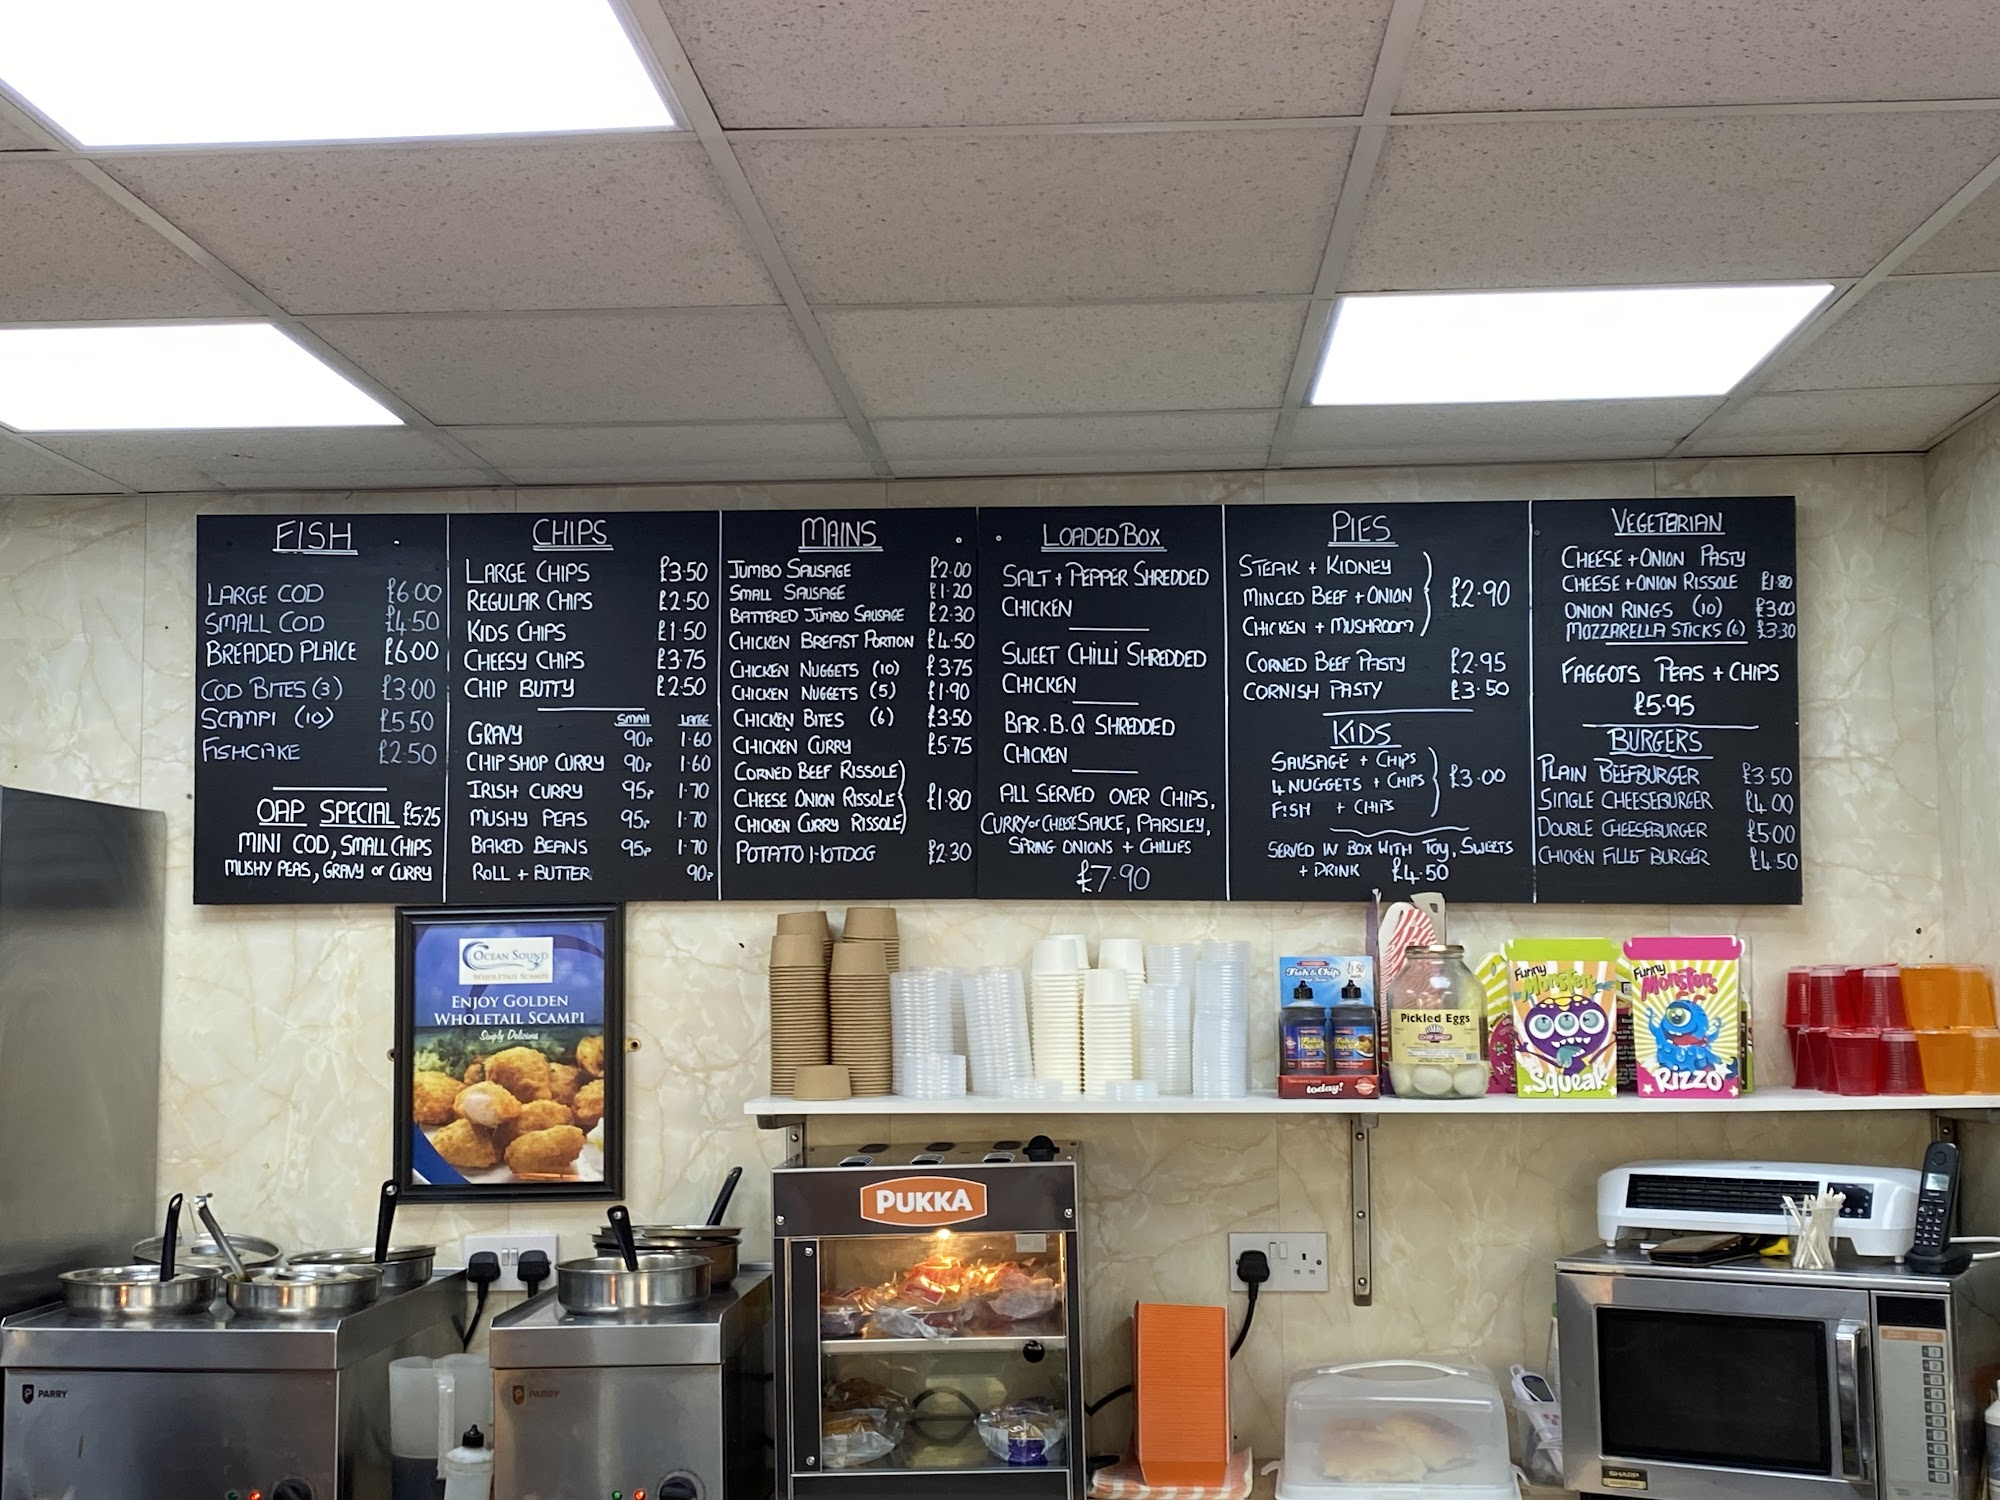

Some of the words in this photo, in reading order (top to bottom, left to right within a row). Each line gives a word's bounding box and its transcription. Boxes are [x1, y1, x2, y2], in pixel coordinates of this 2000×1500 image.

[275, 520, 352, 550] FISH
[532, 519, 607, 545] CHIPS
[801, 518, 876, 547] MAINS
[1043, 524, 1119, 546] LOADED
[1119, 522, 1160, 546] BOX
[1332, 510, 1392, 542] PIES
[1239, 554, 1301, 577] STEAK
[1327, 554, 1391, 575] KIDNEY
[1562, 546, 1623, 568] CHEESE
[1640, 547, 1684, 567] ONION
[1701, 544, 1745, 567] PASTY
[466, 559, 527, 583] LARGE
[536, 560, 590, 582] CHIPS
[727, 560, 782, 578] JUMBO
[787, 558, 851, 578] SAUSAGE
[1003, 564, 1051, 587] SALT
[1065, 562, 1128, 587] PEPPER
[1133, 560, 1209, 586] SHREDDED
[1683, 572, 1738, 590] RISSOLE
[208, 583, 267, 606] LARGE
[278, 584, 324, 603] COD
[467, 589, 540, 611] REGULAR
[729, 584, 772, 601] SMALL
[1312, 586, 1348, 605] BEEF
[1367, 585, 1412, 604] ONION
[730, 607, 799, 623] BATTERED
[1002, 596, 1072, 617] CHICKEN
[1622, 601, 1673, 618] RINGS
[205, 612, 272, 635] SMALL
[279, 611, 324, 632] COD
[468, 619, 509, 642] KIDS
[1242, 616, 1306, 636] CHICKEN
[1331, 617, 1414, 634] MUSHROOM
[1566, 622, 1666, 642] MOZZARELLA
[1671, 621, 1722, 638] STICKS
[729, 631, 790, 650] CHICKEN
[801, 631, 859, 649] BREAST
[864, 629, 914, 648] PORTION
[206, 640, 293, 667] BREADED
[300, 640, 357, 663] PLAICE
[464, 649, 527, 671] CHEESY
[1002, 641, 1060, 665] SWEET
[1127, 642, 1207, 667] SHREDDED
[1246, 651, 1307, 673] CORNED
[1356, 649, 1405, 672] PASTY
[800, 660, 859, 677] NUGGETS
[1562, 656, 1641, 683] FAGGOTS
[1654, 656, 1704, 682] PEAS
[1729, 661, 1779, 681] CHIPS
[249, 676, 306, 699] BITES
[464, 677, 508, 698] CHIP
[520, 678, 574, 698] BUTTY
[1002, 673, 1076, 693] CHICKEN
[1243, 682, 1319, 700] CORNISH
[201, 707, 276, 729] SCAMPI
[803, 708, 844, 728] BITES
[1095, 714, 1175, 736] SHREDDED
[468, 721, 522, 745] GRAVY
[1332, 719, 1392, 747] KIDS
[1607, 728, 1703, 754] BURGERS
[203, 736, 300, 762] FISHCAKE
[808, 735, 851, 754] CURRY
[1004, 743, 1067, 763] CHICKEN
[466, 751, 505, 771] CHIP
[508, 754, 549, 771] SHOP
[555, 753, 604, 771] CURRY
[734, 761, 792, 781] CORNED
[797, 761, 832, 779] BEEF
[840, 760, 899, 779] RISSOLE
[1271, 751, 1349, 772] SAUSAGE
[1376, 750, 1416, 770] CHIPS
[1537, 753, 1586, 782] PLAIN
[1593, 758, 1700, 785] BEEFBURGER
[466, 780, 519, 799] IRISH
[1000, 783, 1029, 802] ALL
[1036, 783, 1095, 803] SERVED
[1109, 788, 1150, 805] OVER
[1288, 777, 1362, 794] NUGGETS
[733, 788, 788, 808] CHEESE
[795, 788, 835, 807] ONION
[1601, 790, 1714, 810] CHEESEBURGER
[257, 799, 305, 823] OAP
[320, 800, 395, 824] SPECIAL
[470, 809, 528, 827] MUSHY
[542, 809, 587, 827] PEAS
[980, 812, 1033, 835] CURRY
[1537, 816, 1593, 837] DOUBLE
[239, 832, 281, 853] MINI
[340, 834, 388, 856] SMALL
[391, 835, 432, 856] CHIPS
[471, 835, 523, 854] BAKED
[533, 835, 588, 854] BEANS
[736, 840, 804, 864] POTATO
[1062, 839, 1113, 854] ONIONS
[1140, 838, 1191, 854] CHILLIES
[1268, 841, 1314, 858] SERVED
[1378, 840, 1412, 857] WITH
[1538, 846, 1594, 865] CHICKEN
[1650, 847, 1710, 866] BURGER
[225, 859, 272, 876] MUSHY
[323, 861, 364, 879] GRAVY
[389, 862, 432, 881] CURRY
[534, 864, 592, 881] BUTTER
[1314, 862, 1360, 877] DRINK
[1285, 967, 1308, 977] Fish
[1317, 966, 1340, 981] Chip
[1514, 964, 1547, 981] Funny
[1634, 963, 1666, 981] Funny
[1522, 970, 1598, 1001] Monsters
[1641, 967, 1718, 1001] Monsters
[452, 996, 499, 1009] ENJOY
[503, 994, 568, 1008] GOLDEN
[434, 1012, 524, 1026] WHOLETAIL
[528, 1011, 585, 1024] SCAMPI
[1400, 1013, 1441, 1023] Pickled
[1446, 1014, 1470, 1025] Eggs
[479, 1030, 504, 1042] Simply
[507, 1029, 538, 1041] Delicious
[1306, 1082, 1344, 1095] today!
[1528, 1067, 1608, 1097] Squeak
[1655, 1066, 1723, 1091] Rizzo
[876, 1189, 973, 1213] PUKKA
[38, 1390, 68, 1398] PARRY
